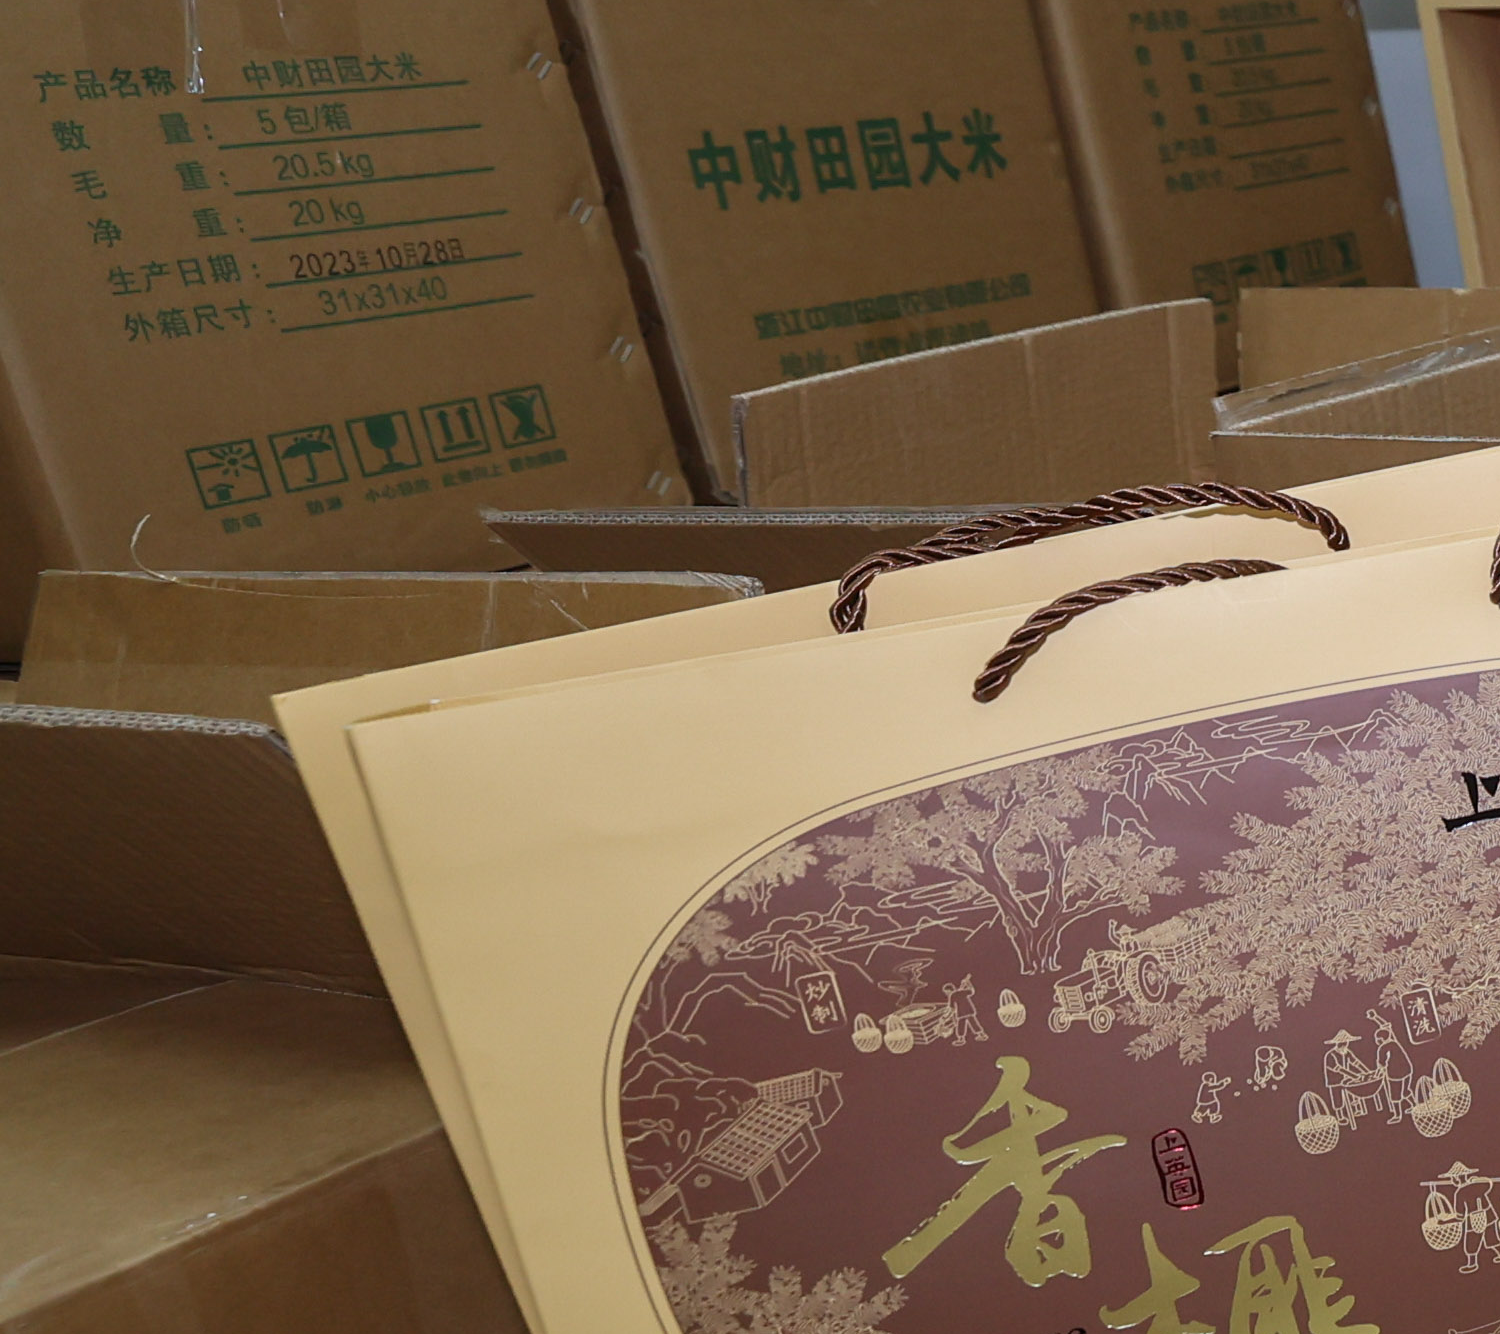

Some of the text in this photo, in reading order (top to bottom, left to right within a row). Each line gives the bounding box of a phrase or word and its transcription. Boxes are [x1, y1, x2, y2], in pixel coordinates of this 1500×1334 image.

[242, 52, 425, 92] 中财田园大米
[686, 107, 1008, 211] 中财田园大米
[803, 977, 844, 1029] 炒制
